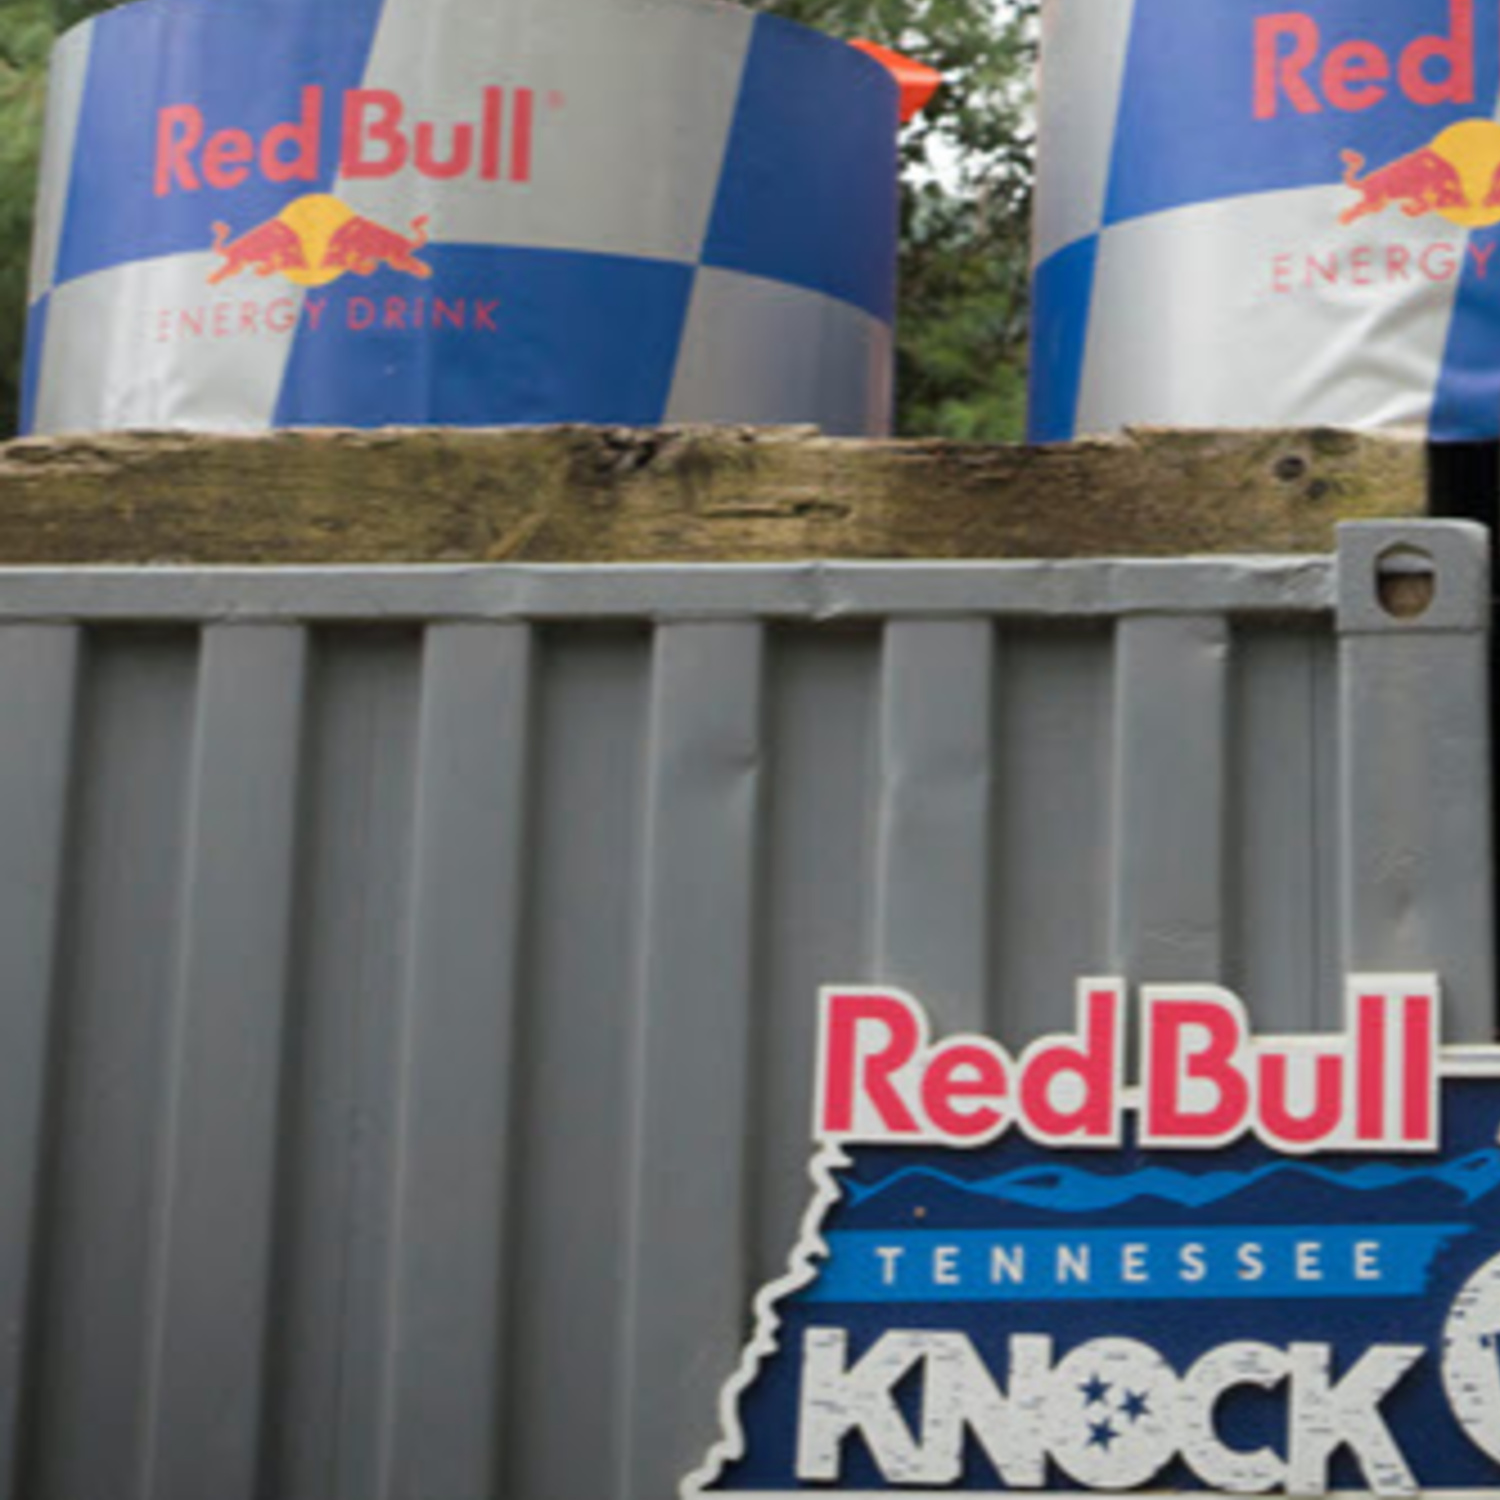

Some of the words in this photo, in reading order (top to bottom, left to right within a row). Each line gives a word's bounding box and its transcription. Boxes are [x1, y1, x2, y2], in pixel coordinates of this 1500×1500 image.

[153, 85, 323, 197] Red
[339, 85, 534, 182] Bull
[1271, 242, 1496, 294] ENERGY
[157, 298, 327, 342] ENERGY
[347, 296, 499, 331] DRINK
[822, 990, 1117, 1138] Red
[1147, 994, 1431, 1144] Bull
[877, 1241, 1381, 1284] TENNESSEE
[795, 1326, 1426, 1496] KNOCK
